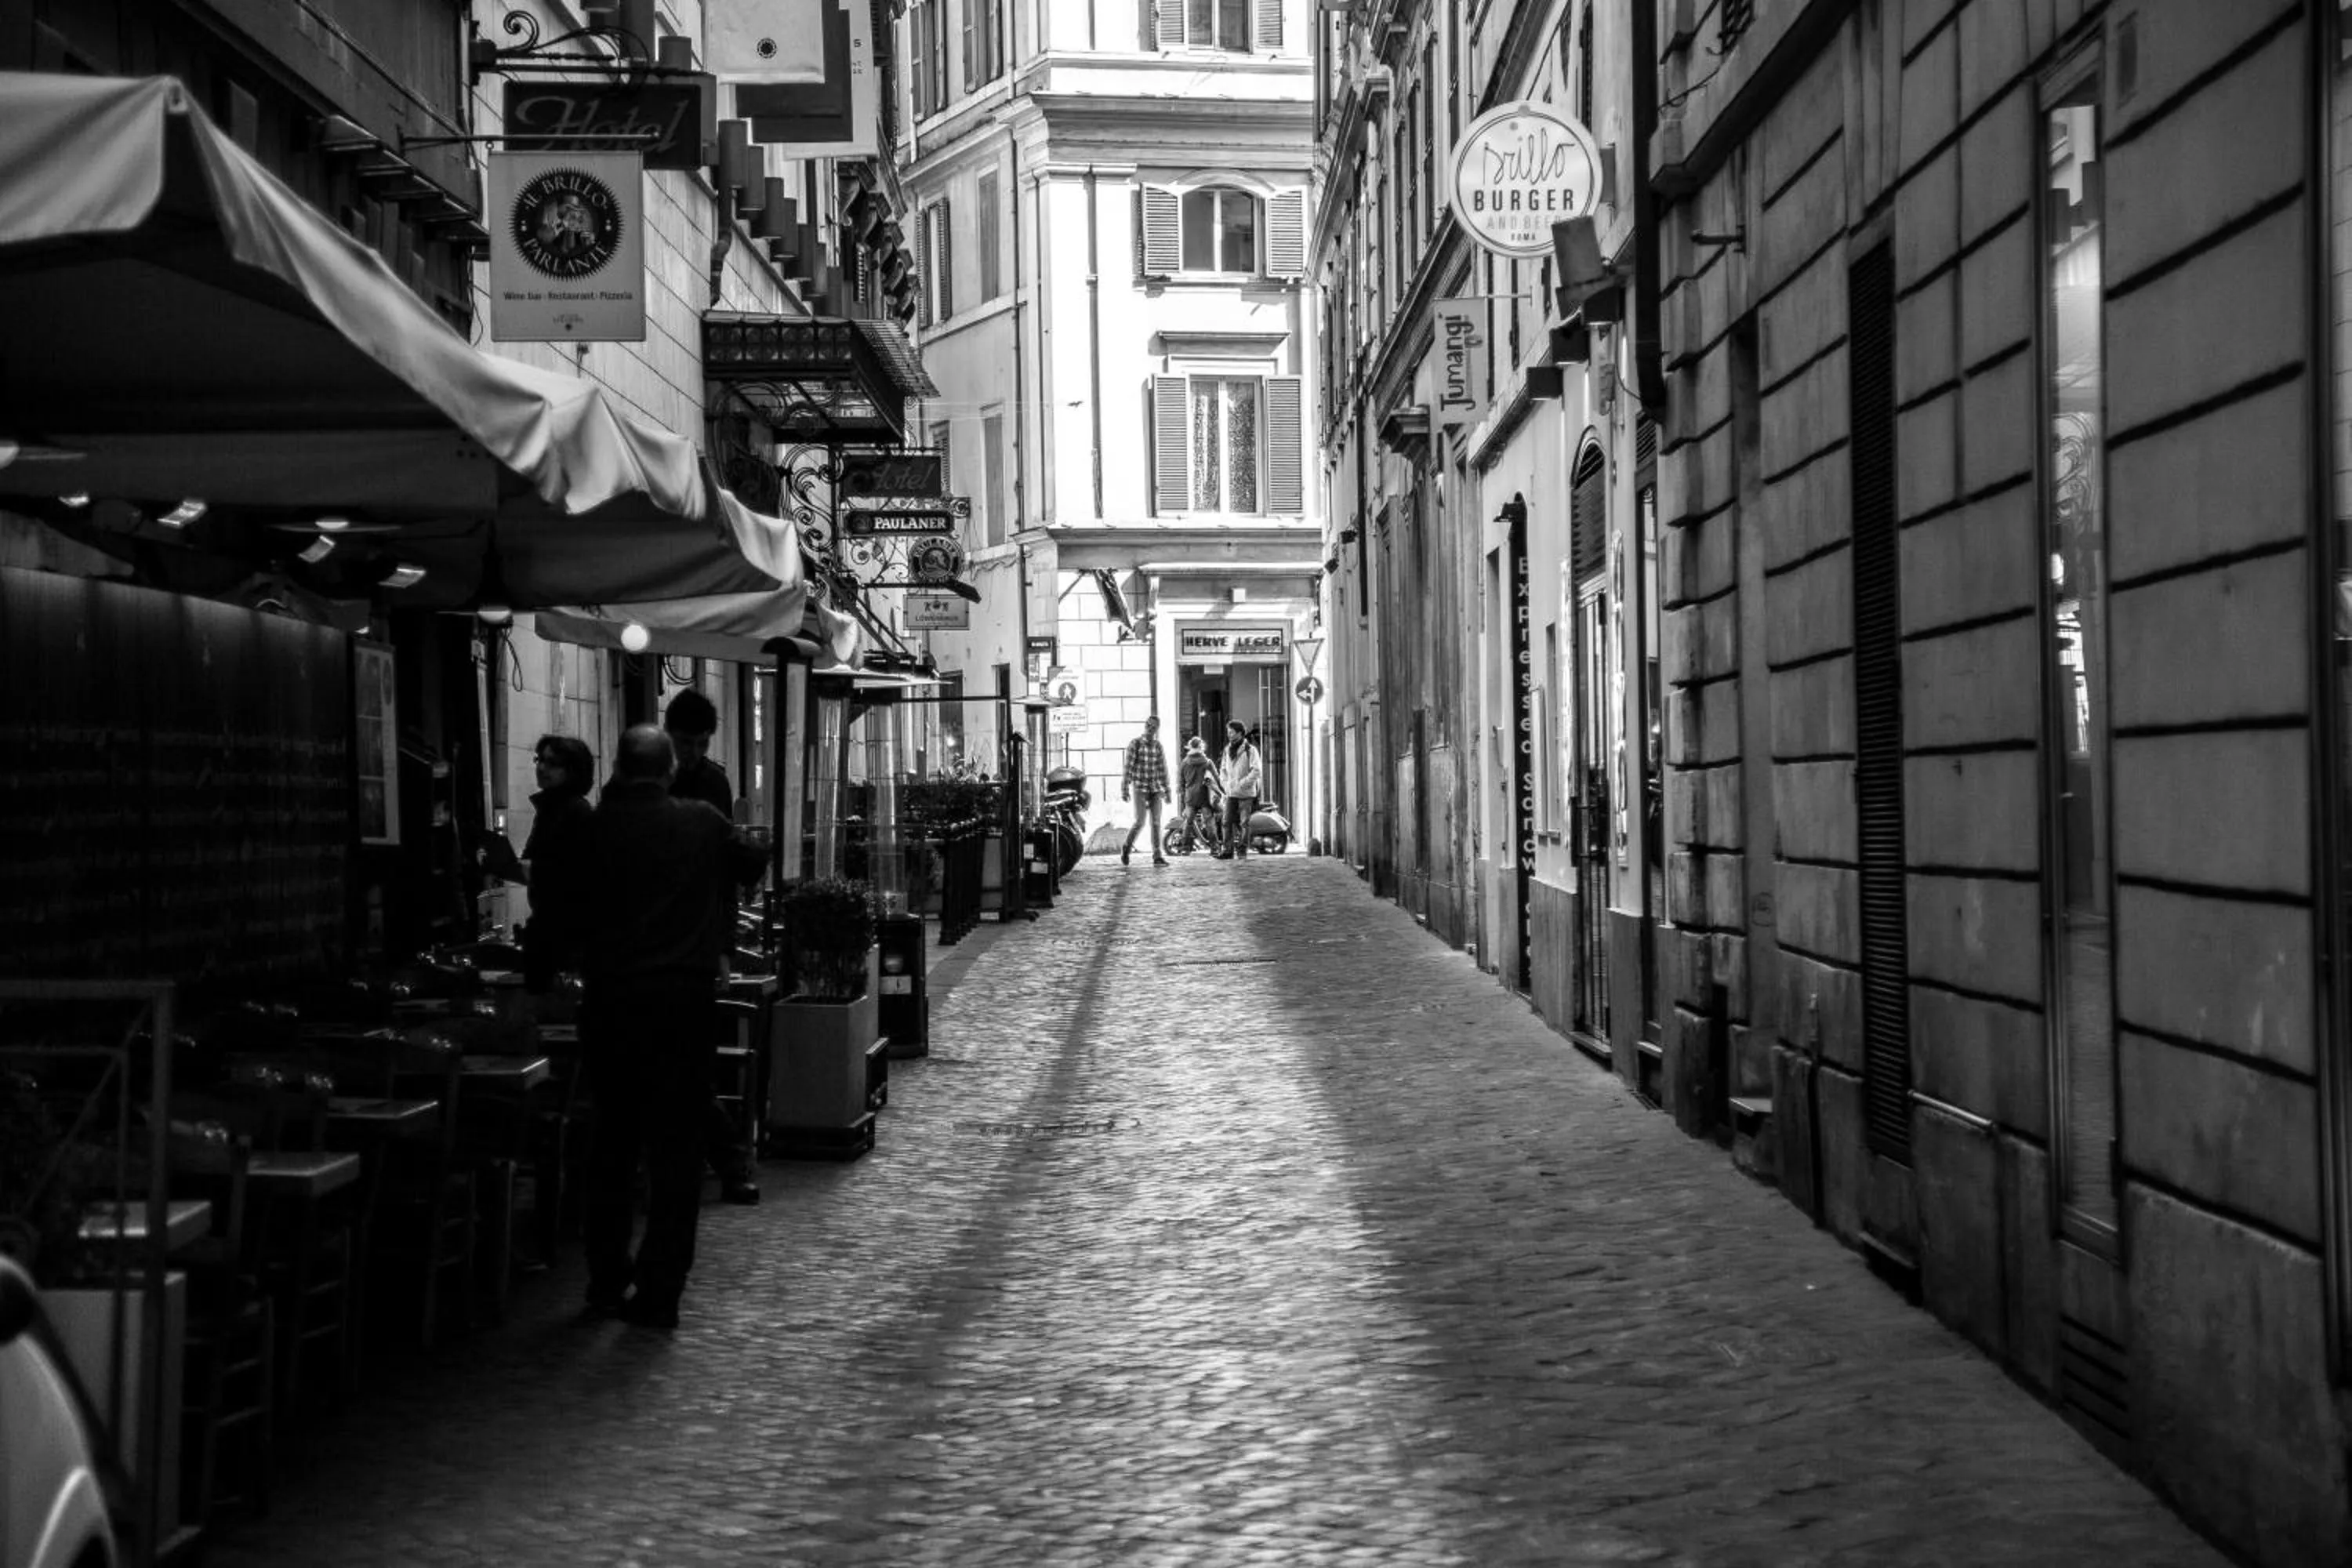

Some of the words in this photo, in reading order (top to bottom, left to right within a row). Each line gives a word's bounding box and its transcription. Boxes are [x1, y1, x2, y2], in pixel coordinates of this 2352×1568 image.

[515, 96, 689, 152] Hotel
[542, 175, 607, 208] BRILLO
[1474, 189, 1573, 212] BURGER
[1486, 215, 1517, 230] AND
[523, 238, 609, 274] PARLANTE
[1439, 312, 1476, 412] Jumangi
[874, 517, 946, 529] PAULANER
